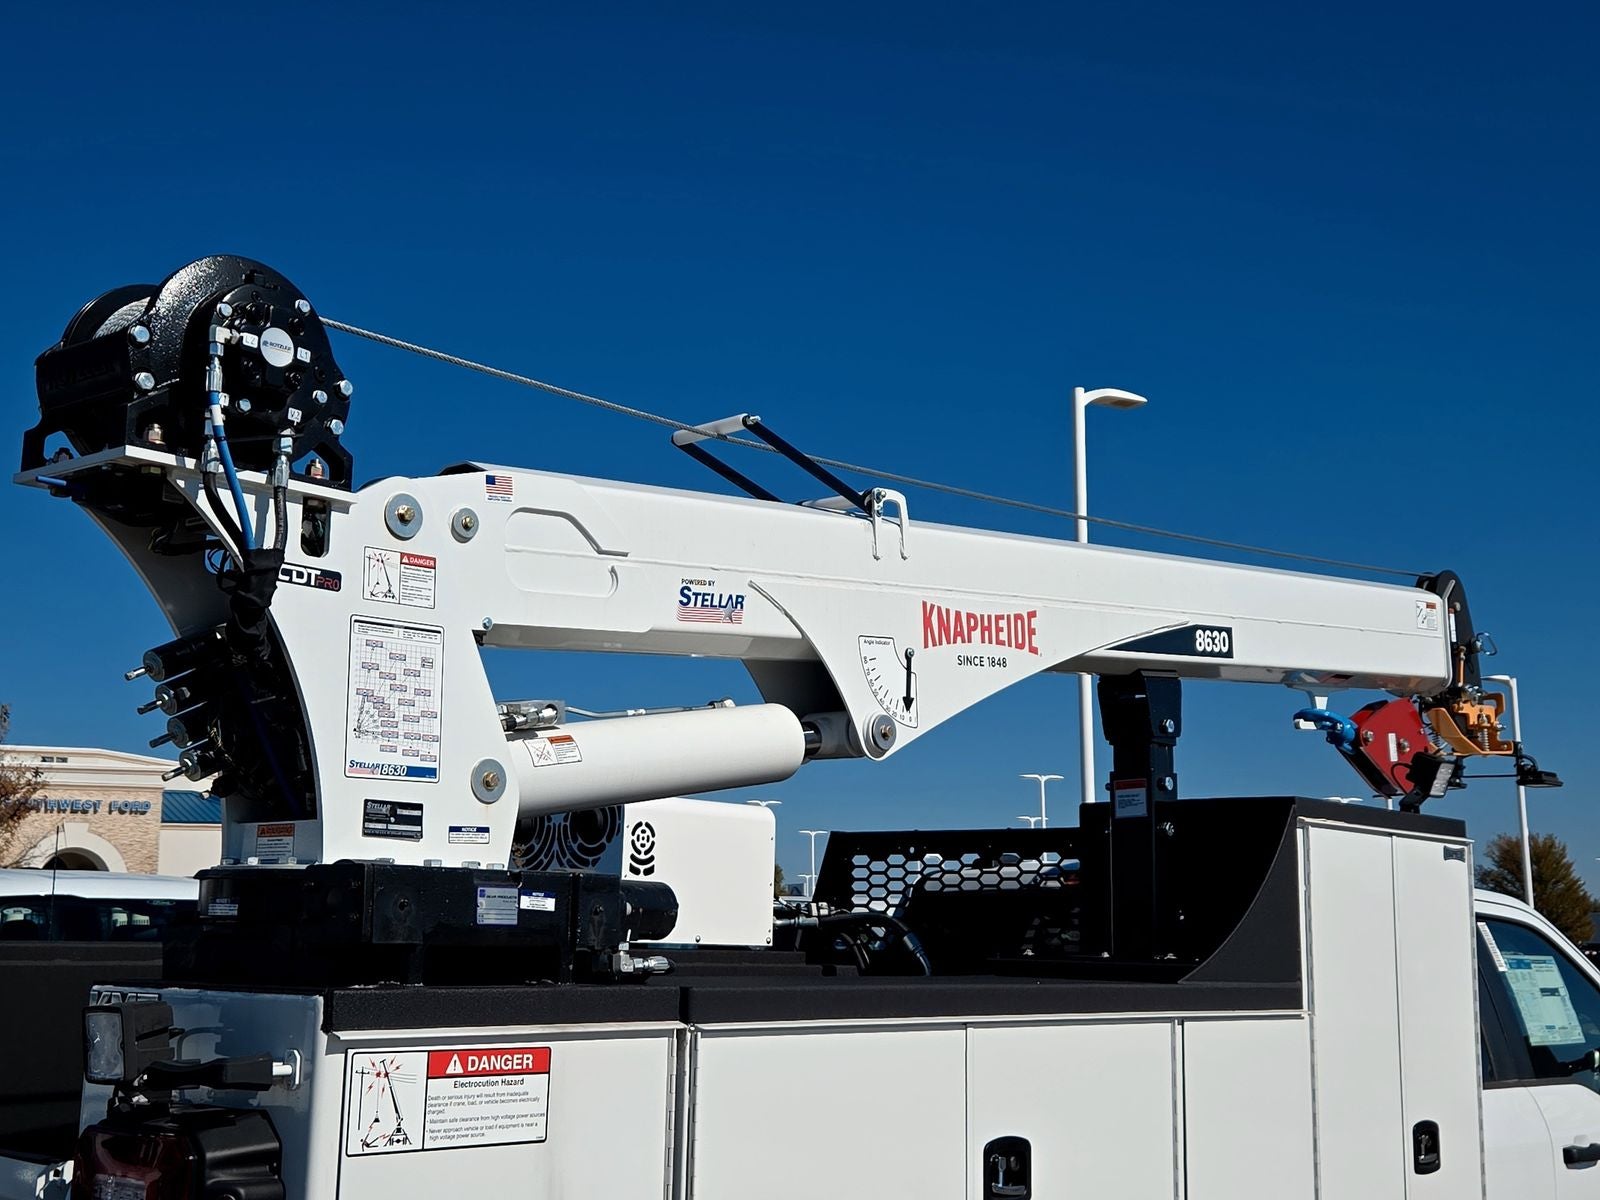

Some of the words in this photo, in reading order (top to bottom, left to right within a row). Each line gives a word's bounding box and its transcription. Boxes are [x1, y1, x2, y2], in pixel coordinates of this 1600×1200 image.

[409, 557, 434, 567] DANGER
[681, 578, 707, 586] POWERED
[678, 585, 745, 609] STELLAR
[922, 600, 1038, 655] KNAPHEIDE
[1195, 629, 1229, 654] 8630
[957, 655, 985, 667] SINCE
[987, 656, 1007, 668] 1848
[349, 759, 381, 769] STELLAR
[381, 764, 407, 776] 8630
[111, 800, 152, 811] FORD
[467, 1053, 534, 1072] DANGER
[454, 1080, 500, 1088] Electrocution
[501, 1078, 524, 1086] Hazard
